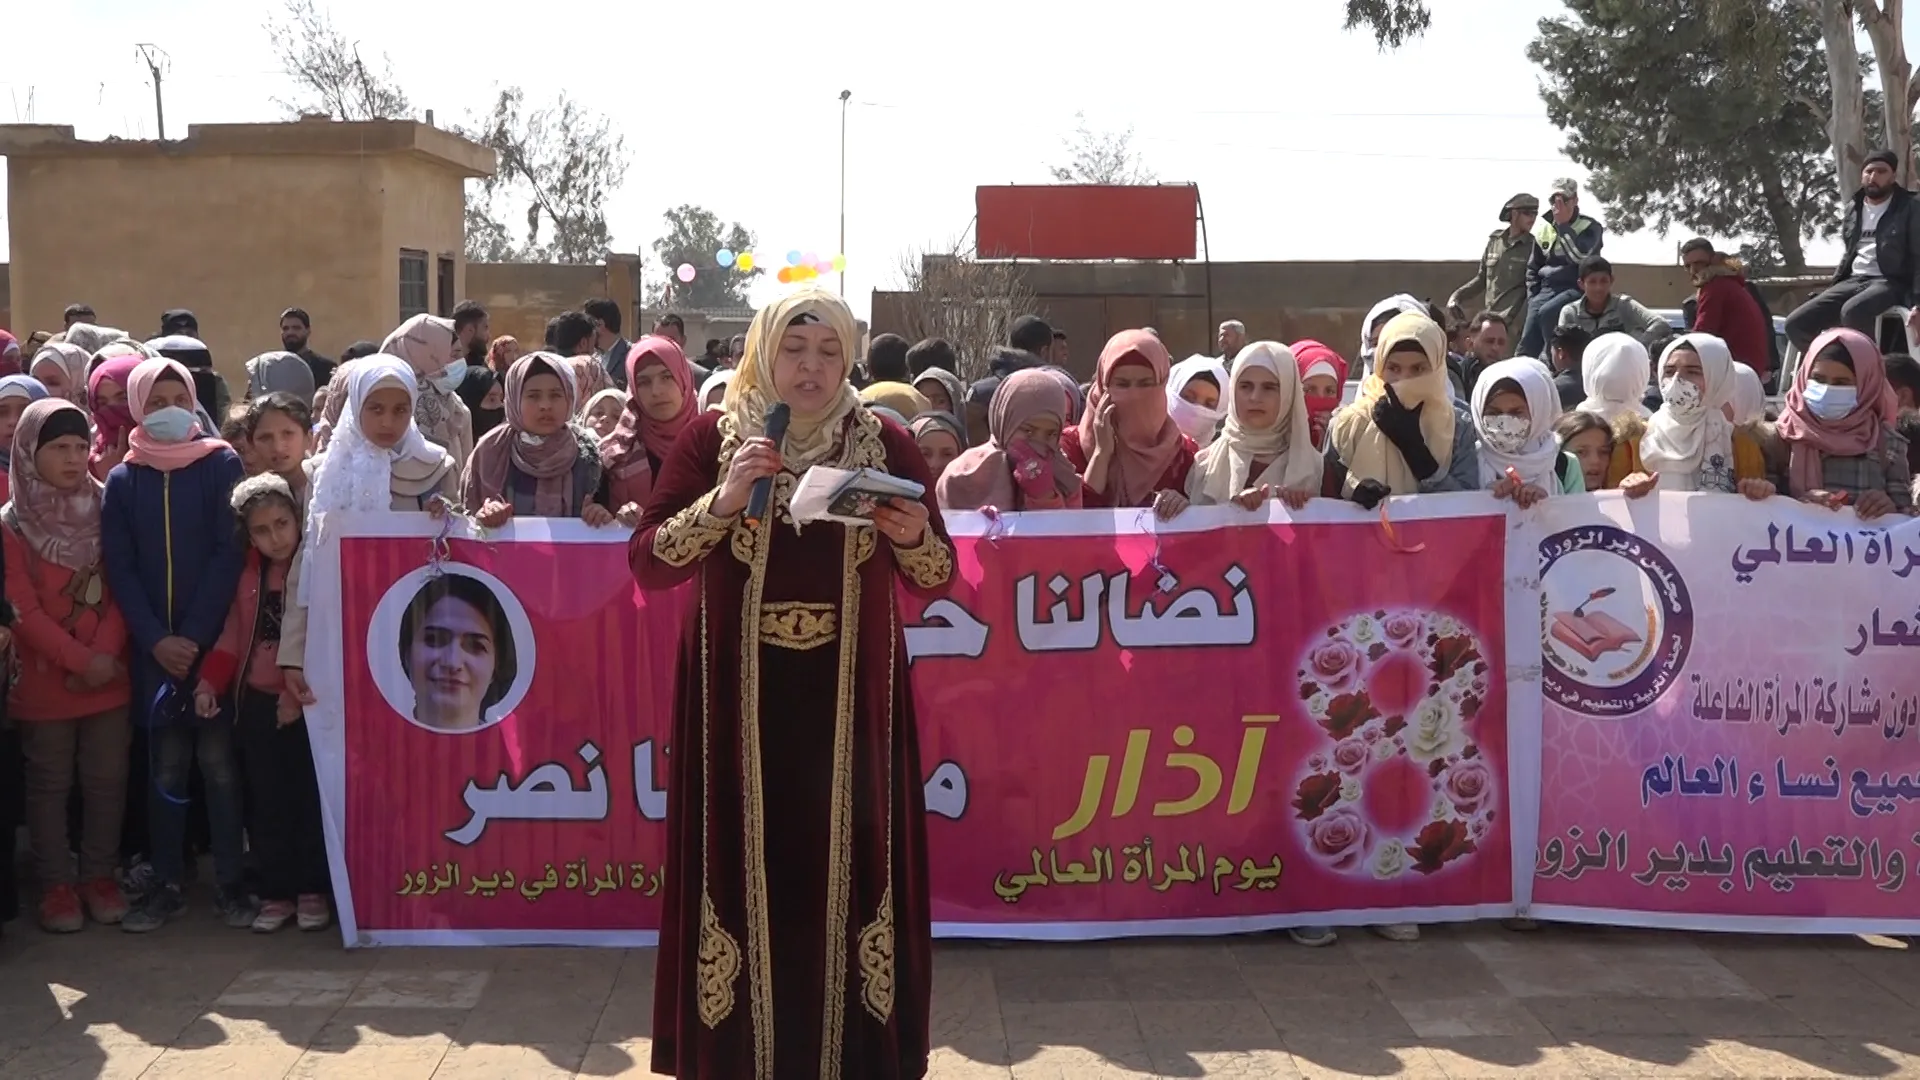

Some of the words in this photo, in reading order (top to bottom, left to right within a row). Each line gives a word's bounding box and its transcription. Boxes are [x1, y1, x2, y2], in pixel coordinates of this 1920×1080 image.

[1555, 530, 1604, 556] الزور
[1605, 537, 1640, 556] دير
[1731, 521, 1854, 583] العالمي
[1016, 565, 1255, 650] نضالنا
[1640, 557, 1682, 613] مجلس
[1691, 673, 1760, 722] الفاعلة
[1763, 673, 1808, 736] المرأة
[1813, 677, 1881, 737] مشاركة
[444, 740, 609, 846] نصر
[1052, 715, 1280, 840] آذار
[1641, 755, 1738, 807] العالم
[396, 862, 461, 896] الزور
[564, 857, 624, 897] المرأة
[993, 843, 1113, 903] العالمي
[1122, 837, 1206, 892] المرأة
[1213, 853, 1283, 895] يوم
[1536, 825, 1628, 880] الزو
[1631, 836, 1735, 892] بدير
[1742, 835, 1906, 892] والتعليم
[464, 868, 515, 898] دير
[519, 862, 559, 901] في
